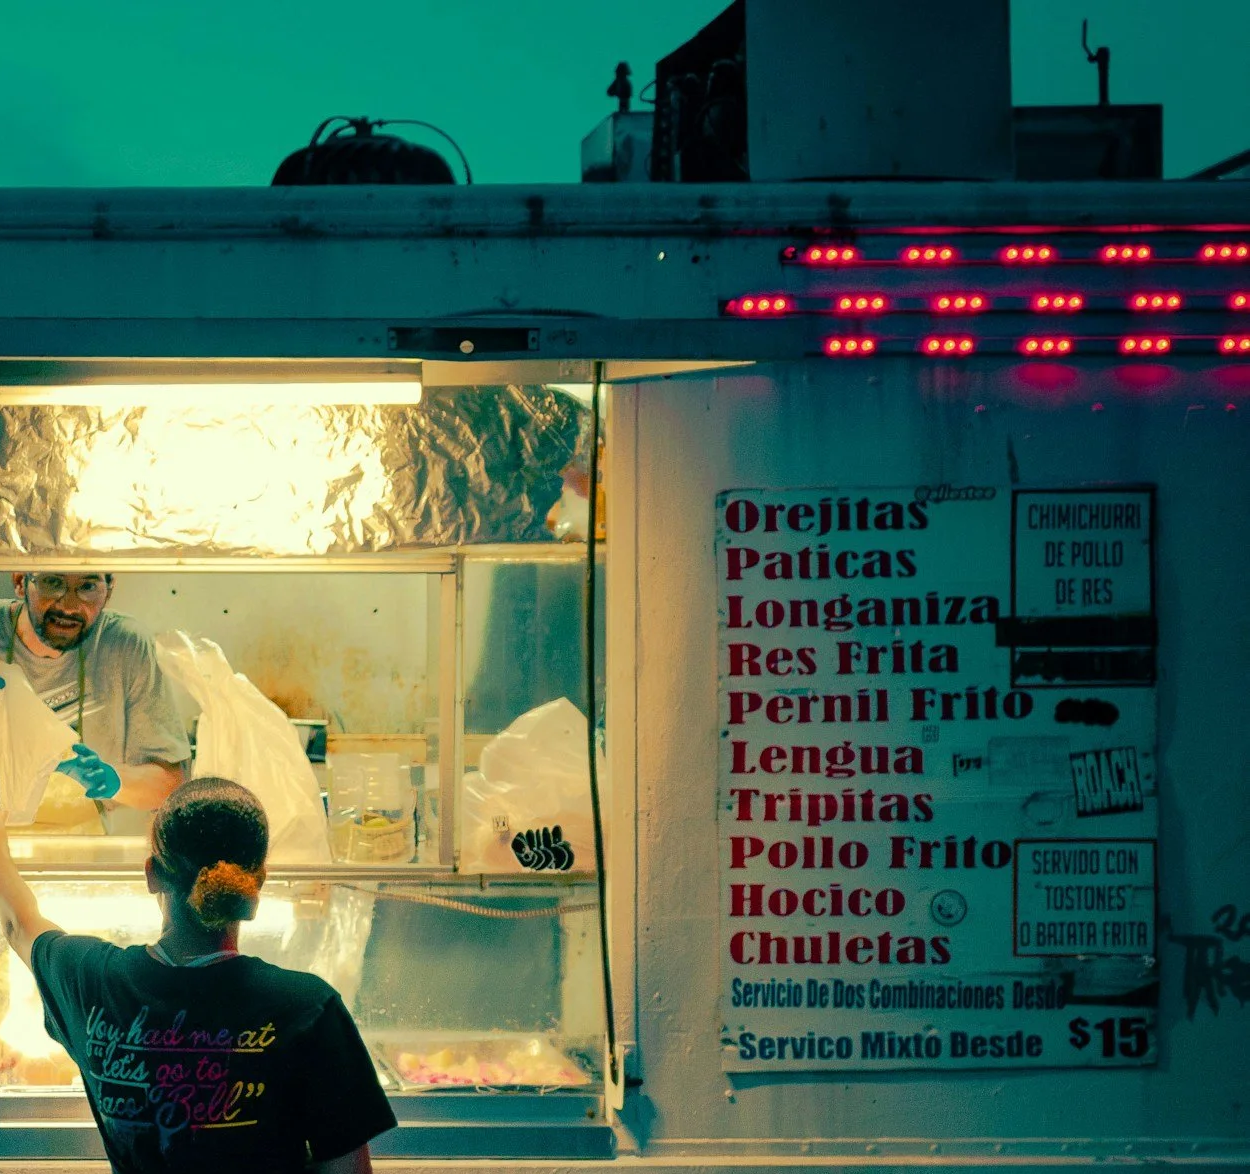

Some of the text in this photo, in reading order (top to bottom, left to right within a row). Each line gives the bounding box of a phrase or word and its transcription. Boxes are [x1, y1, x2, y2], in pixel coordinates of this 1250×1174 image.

[726, 497, 929, 536] Orejitas
[1027, 503, 1141, 530] CHIMICHURRI
[726, 548, 917, 580] Paticas
[1045, 541, 1123, 567] DE POLLO
[1056, 580, 1112, 605] DE RES
[727, 591, 1000, 631] Longaniza
[728, 640, 958, 676] Res Frita
[728, 687, 1033, 725] Pernil Frito
[731, 740, 923, 778] Lengua
[730, 789, 933, 826] Tripitas
[730, 836, 1011, 868] Pollo Frito
[1032, 850, 1138, 874] SERVIDO CON
[730, 884, 905, 916] Hocico
[730, 931, 951, 964] Chuletas
[1020, 921, 1147, 947] O BATATA FRITA
[732, 979, 1066, 1010] Servicio De Dos Combinaciones Desde
[86, 1005, 276, 1050] You had me at
[739, 1017, 1148, 1060] Servico Mixto Desde $15
[155, 1063, 190, 1087] go
[196, 1056, 229, 1081] to
